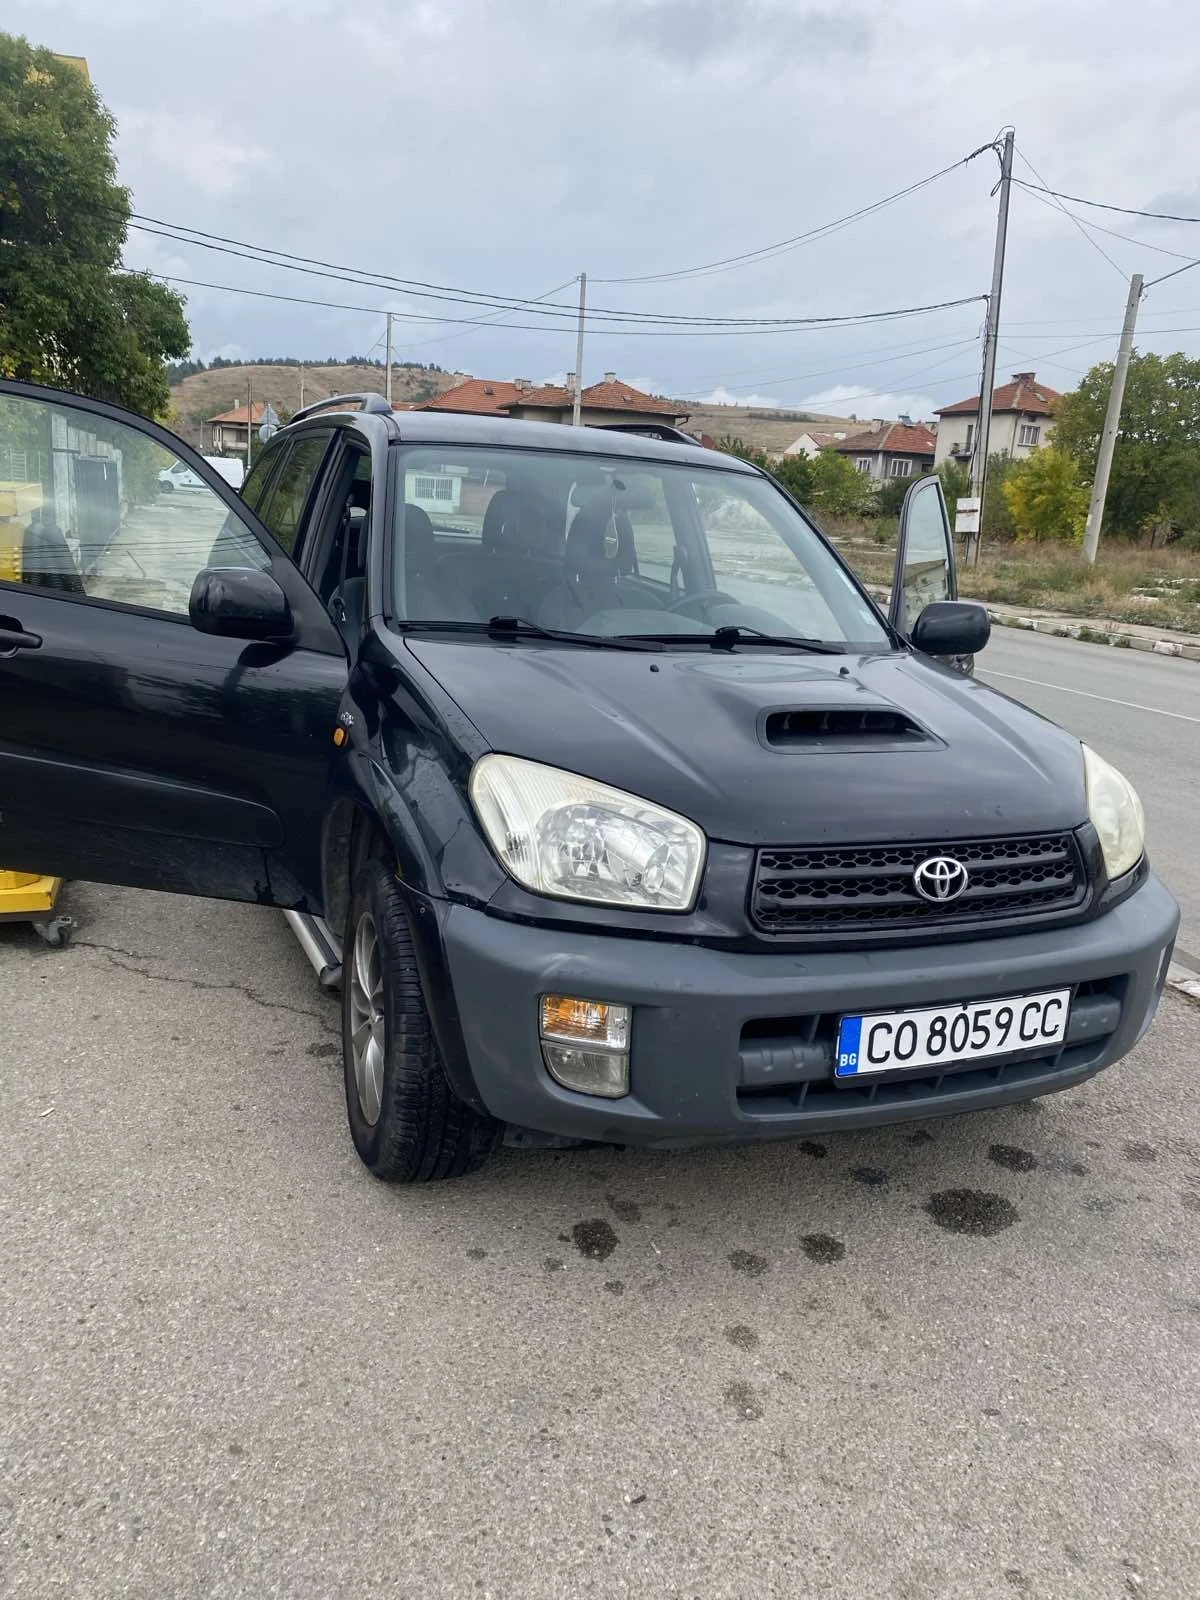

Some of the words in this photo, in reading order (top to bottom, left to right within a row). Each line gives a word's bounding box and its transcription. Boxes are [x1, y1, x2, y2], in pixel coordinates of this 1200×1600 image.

[867, 1019, 918, 1064] CO
[926, 1006, 1014, 1056] 8059
[1019, 998, 1062, 1042] CC
[839, 1052, 857, 1067] BG
